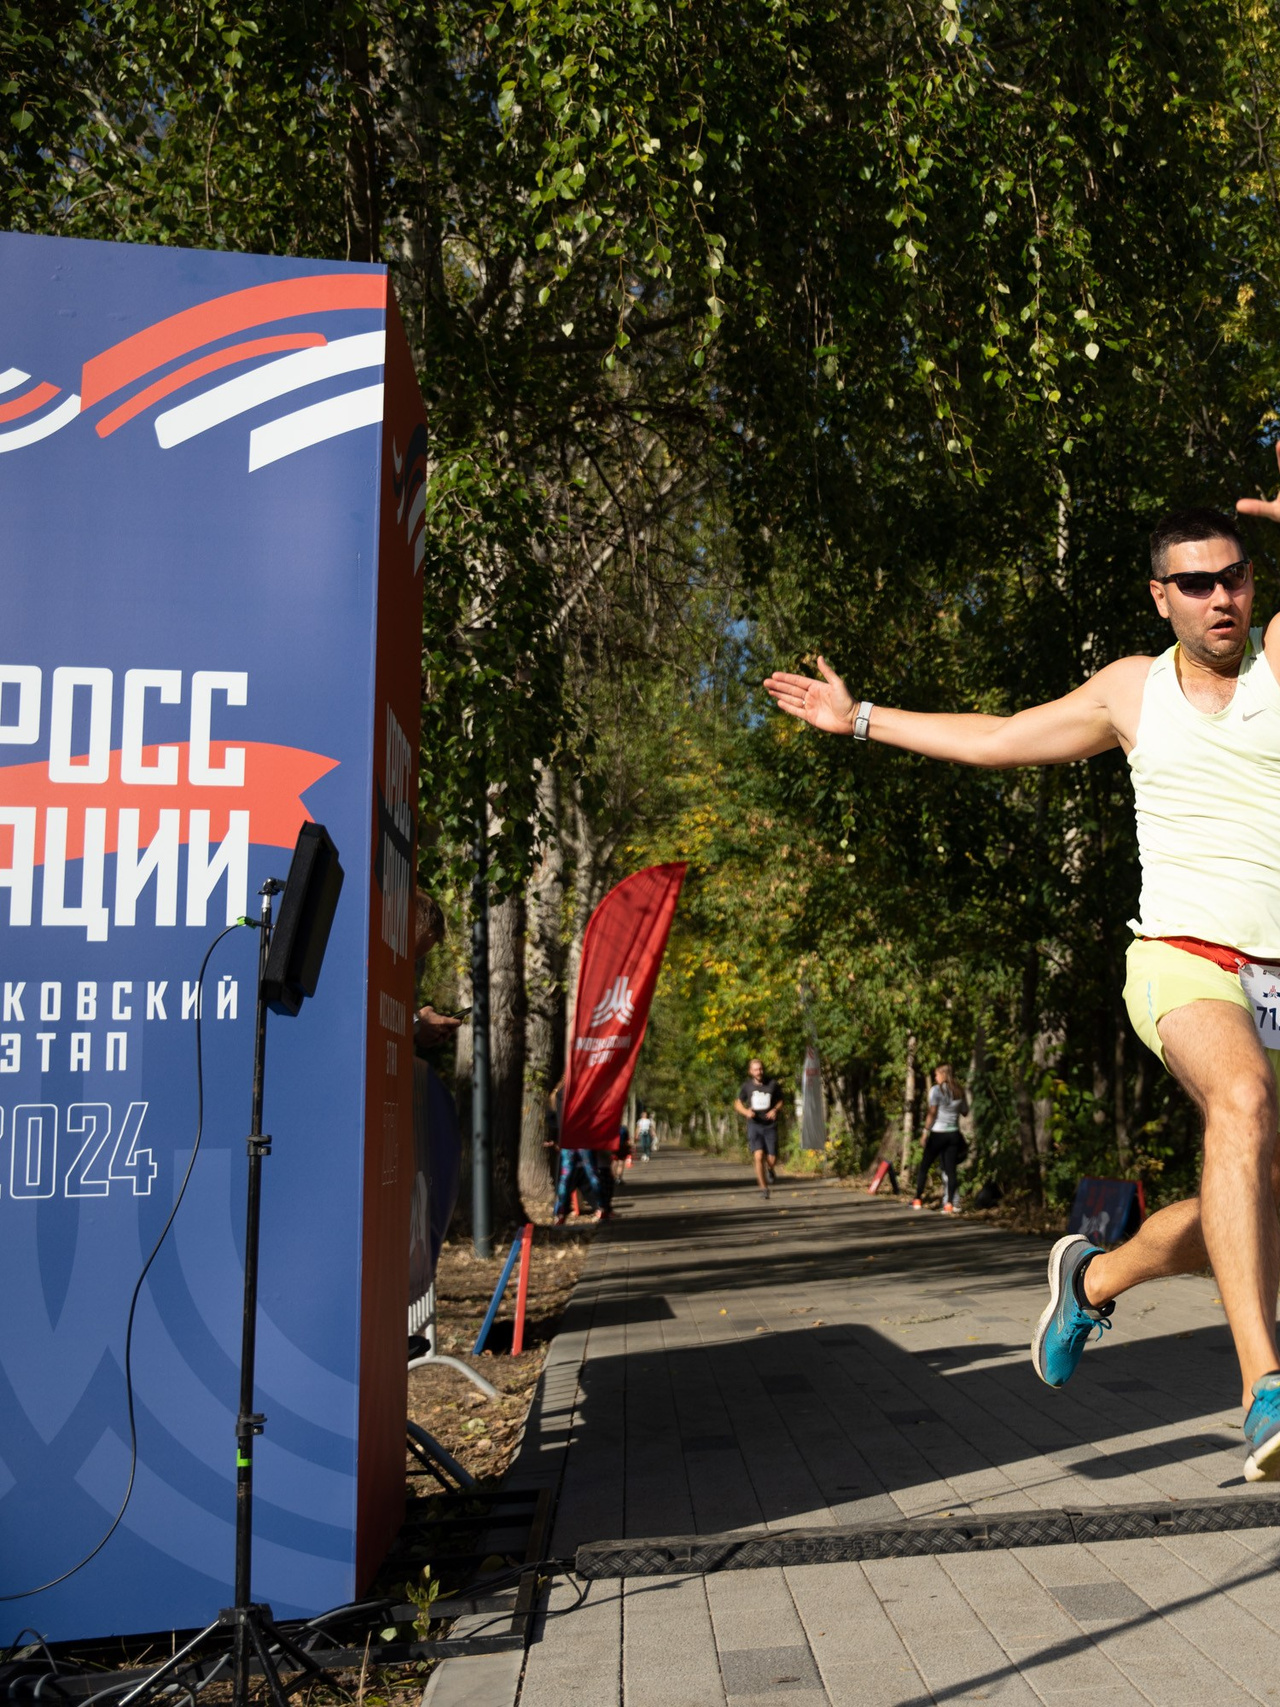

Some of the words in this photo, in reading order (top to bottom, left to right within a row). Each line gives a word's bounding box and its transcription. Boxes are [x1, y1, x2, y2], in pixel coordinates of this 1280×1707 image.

[384, 702, 412, 843] КРОСС
[3, 975, 238, 1021] КОВСКИЙ
[0, 1031, 128, 1073] ЭТАП
[0, 1101, 158, 1199] 024
